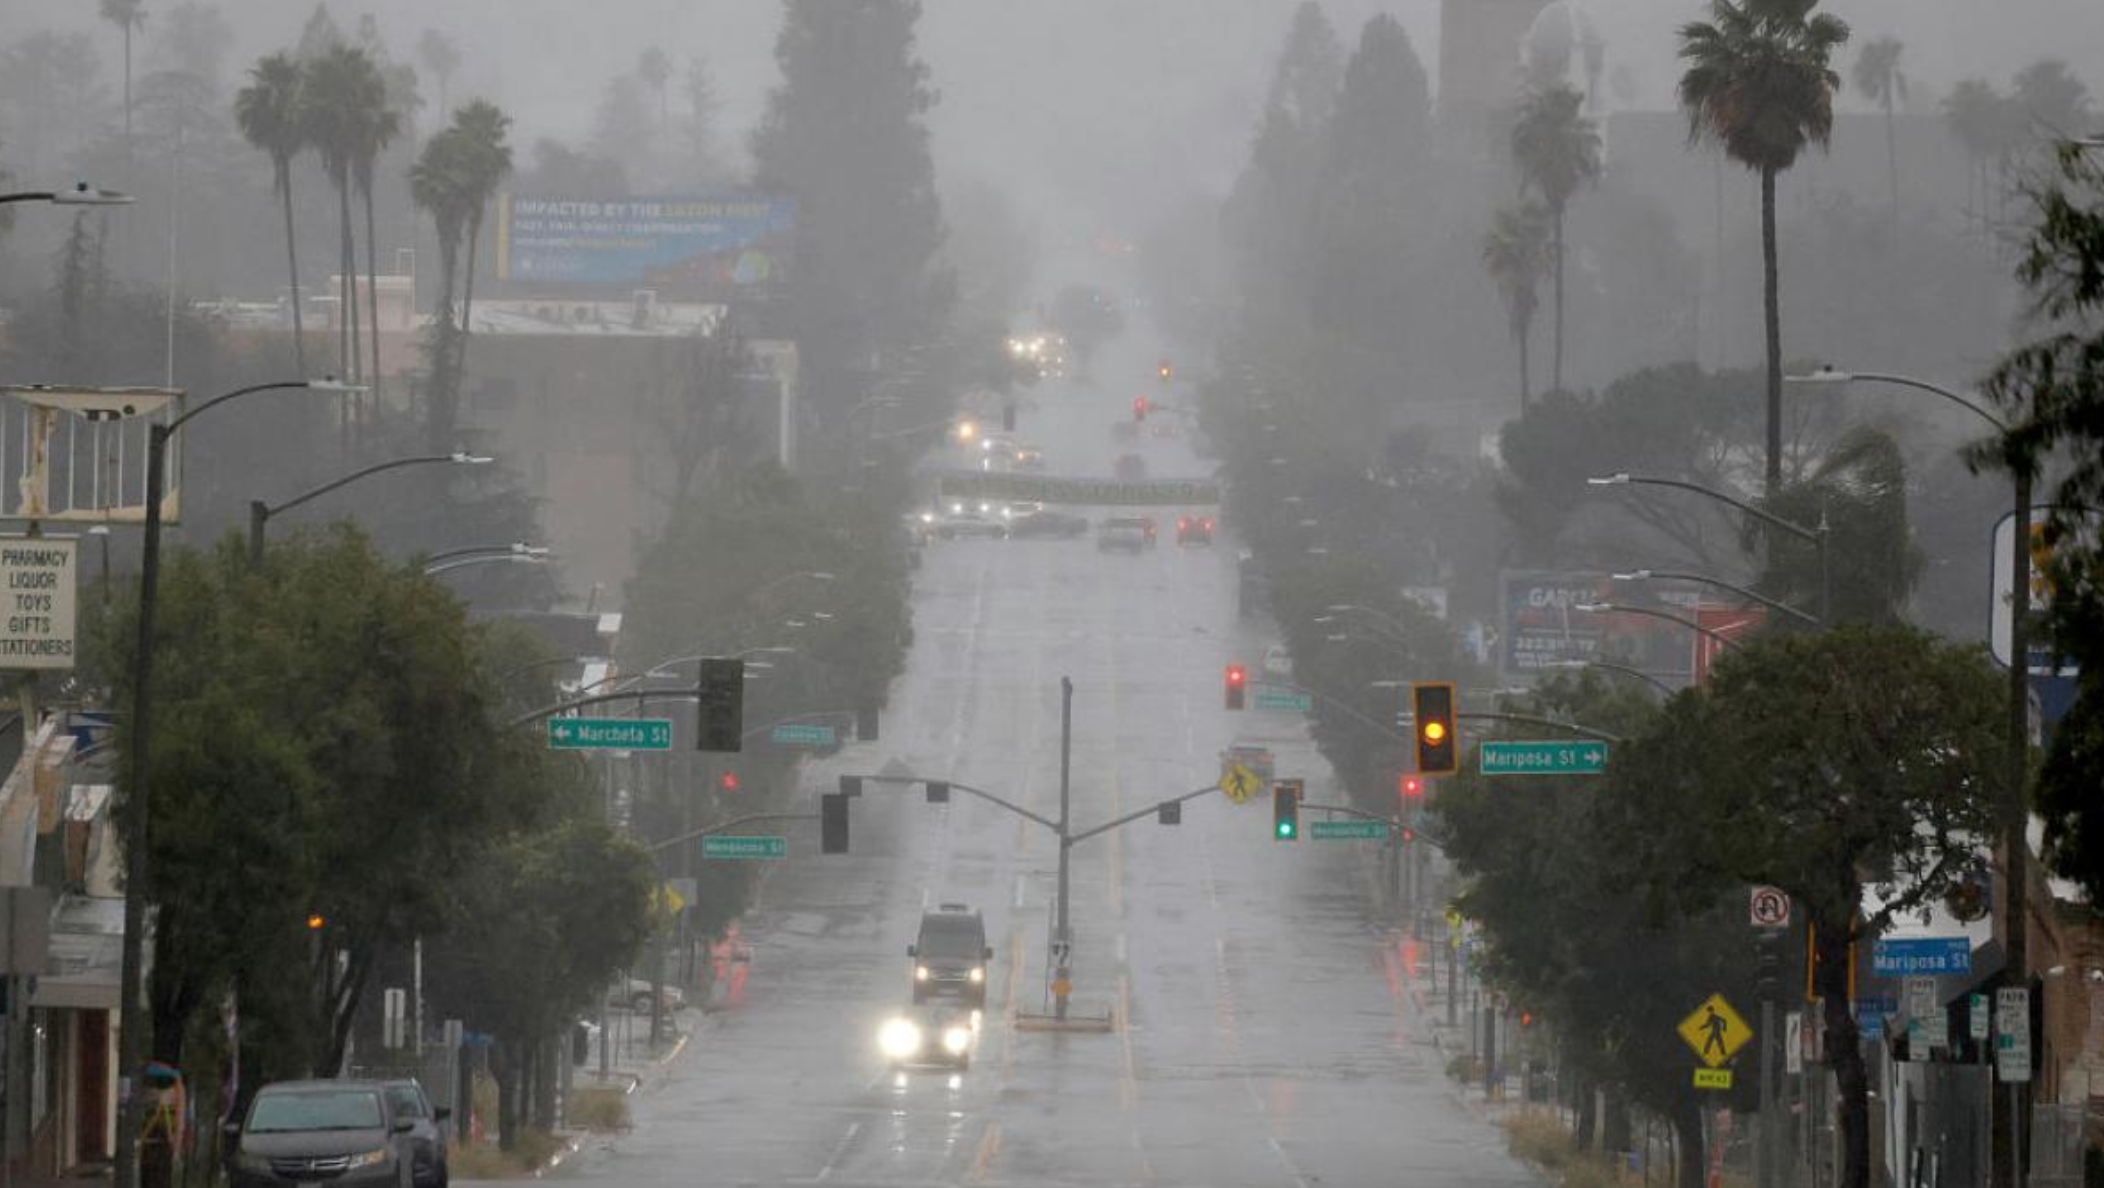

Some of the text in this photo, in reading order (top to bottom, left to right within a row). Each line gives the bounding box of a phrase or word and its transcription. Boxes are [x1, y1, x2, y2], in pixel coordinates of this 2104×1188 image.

[2, 548, 68, 566] PHARMACY
[9, 571, 57, 589] LIQUOR
[16, 594, 51, 610] TOYS
[9, 616, 50, 633] GIFTS
[0, 639, 72, 655] TATIONERS
[577, 725, 668, 742] Marcheta St
[1485, 749, 1576, 769] Mariposa St
[1872, 951, 1969, 973] Mariposa St
